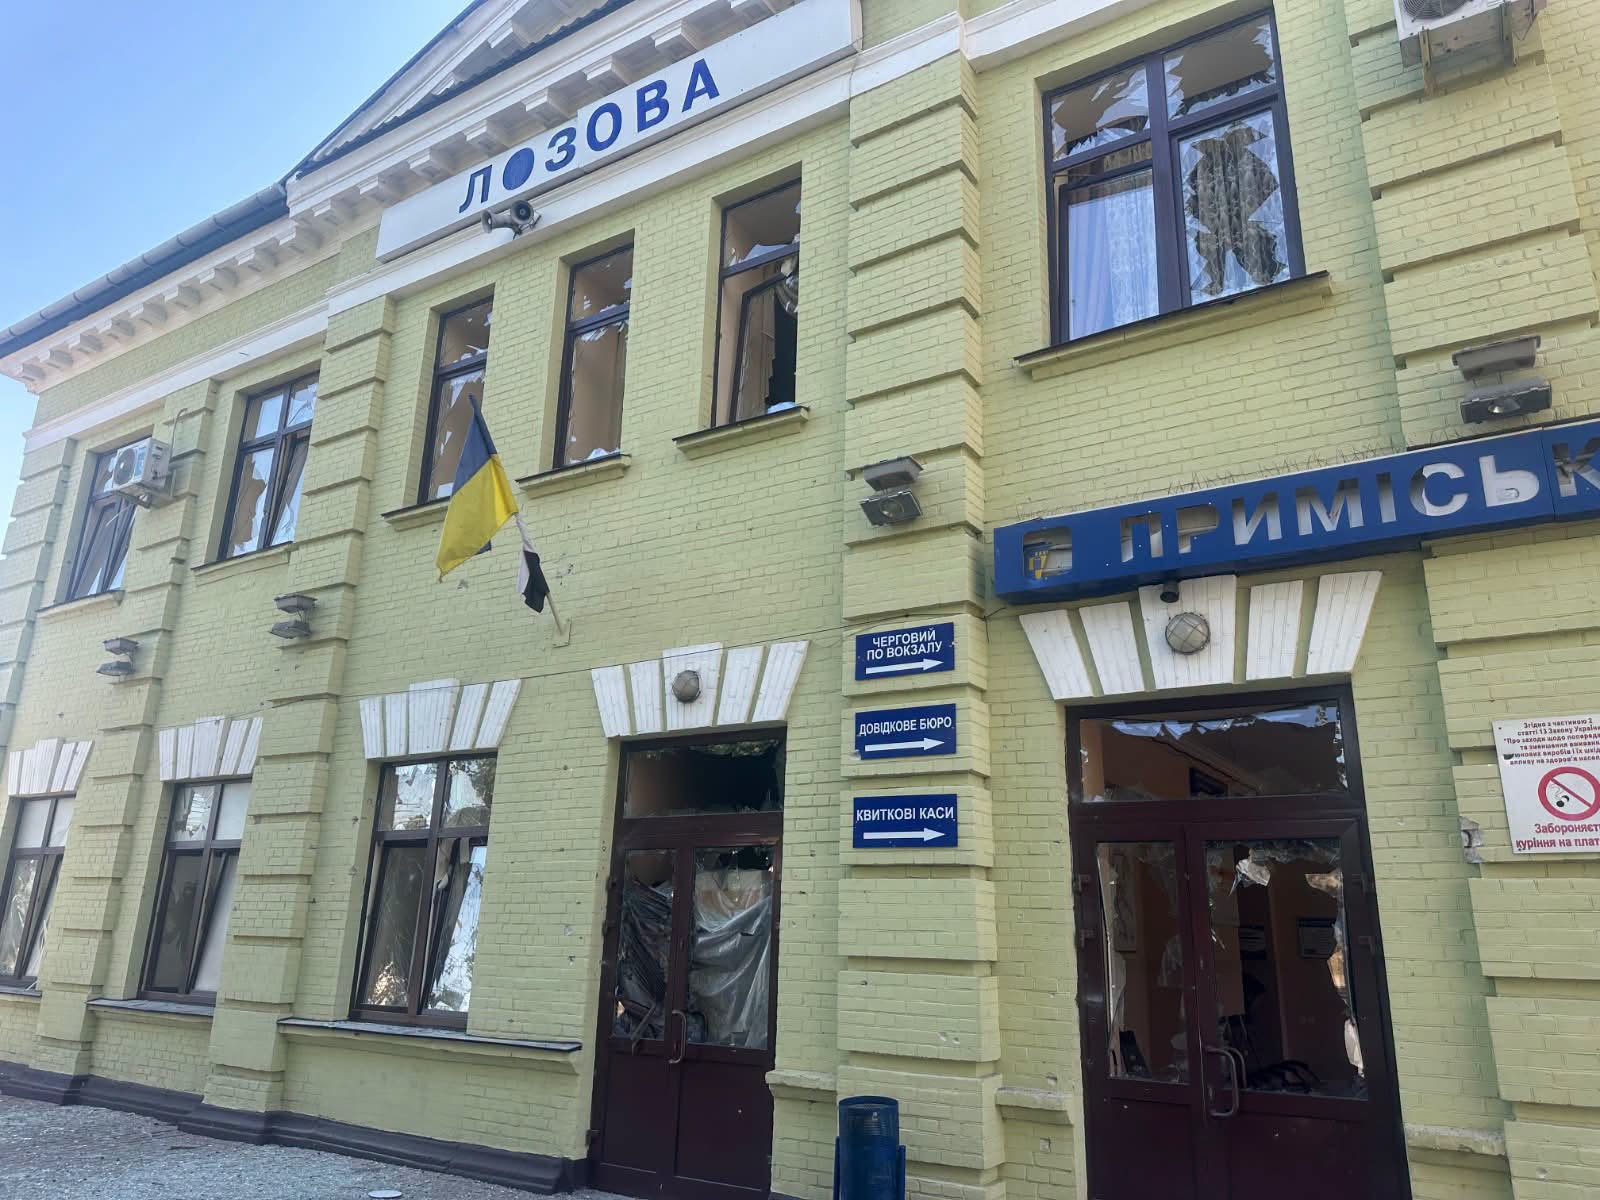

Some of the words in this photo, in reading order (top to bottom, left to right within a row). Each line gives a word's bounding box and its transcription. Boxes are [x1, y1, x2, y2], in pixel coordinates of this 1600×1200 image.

[458, 58, 720, 214] ЛОЗОВА
[872, 628, 936, 648] ЧЕРГОВИЙ
[866, 649, 884, 661] ПО
[886, 641, 943, 658] ВОКЗАЛУ
[859, 719, 918, 736] ДОВІДКОВЕ
[919, 716, 952, 730] БЮРО
[856, 807, 916, 822] КВИТКОВІ
[919, 806, 954, 820] КАСИ
[1534, 823, 1600, 836] Забороняєт
[1516, 837, 1556, 850] куріння
[1558, 839, 1572, 847] на
